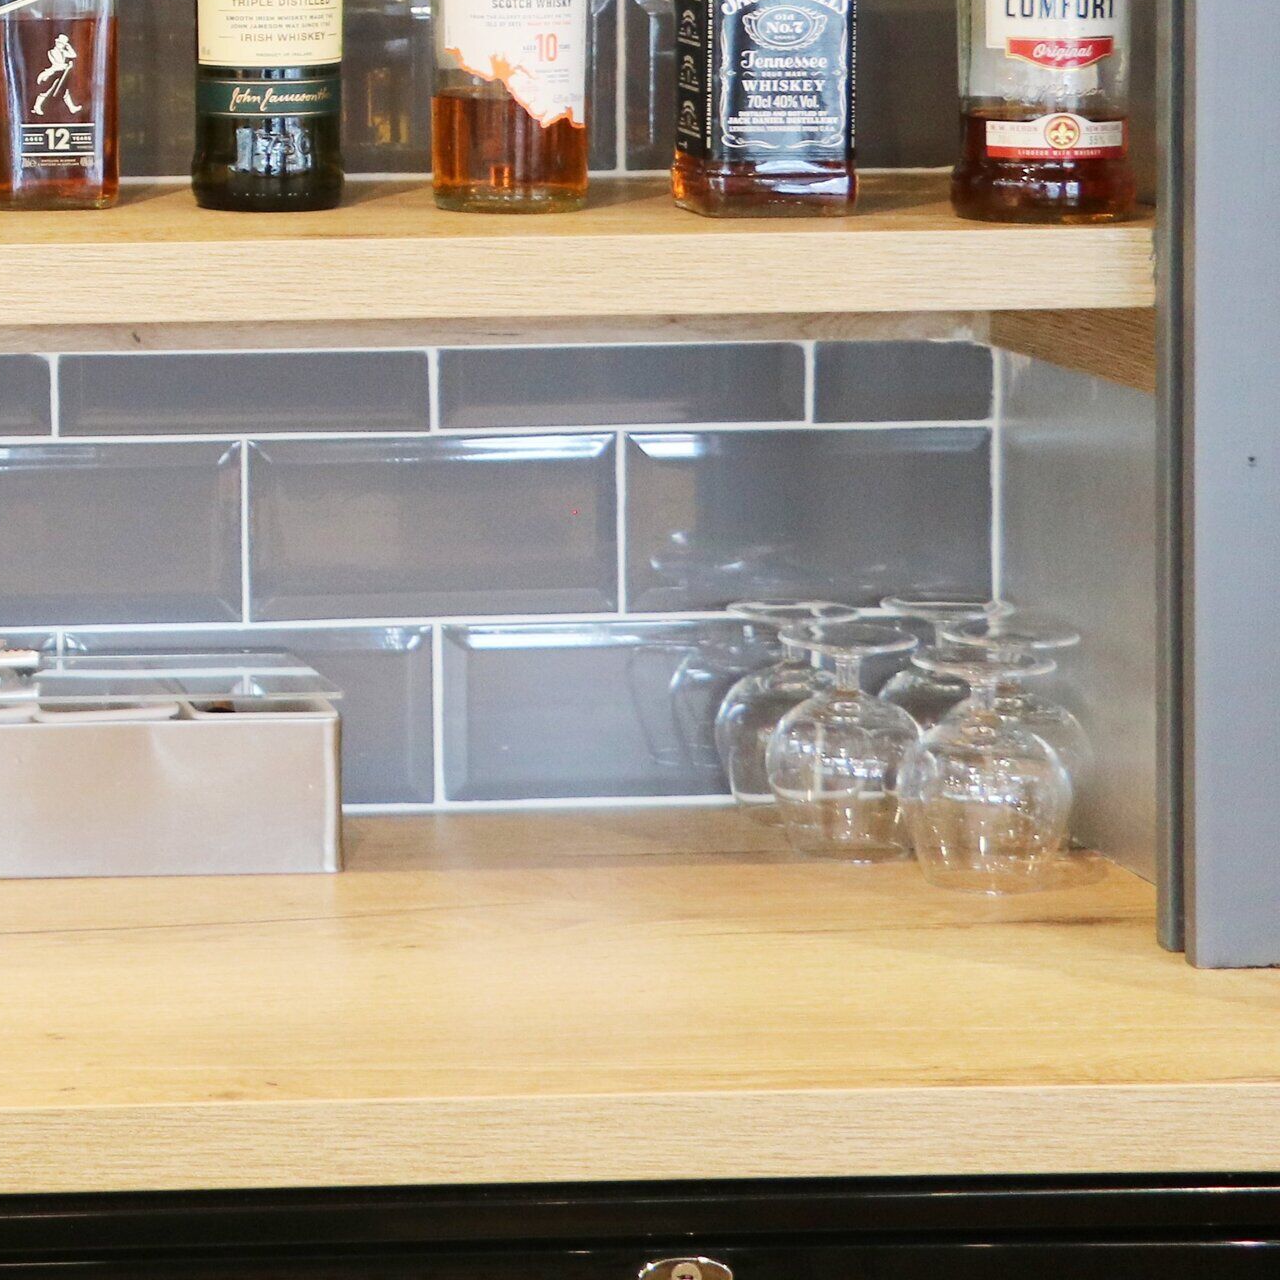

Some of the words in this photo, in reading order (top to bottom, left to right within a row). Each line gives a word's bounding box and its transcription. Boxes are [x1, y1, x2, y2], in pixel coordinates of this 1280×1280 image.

[240, 33, 274, 42] IRISH
[277, 31, 327, 42] WHISKEY
[535, 33, 558, 62] 10
[1032, 44, 1093, 61] Original
[740, 49, 829, 69] Tennessee
[740, 79, 827, 93] WHISKEY
[229, 86, 261, 112] John
[746, 94, 772, 109] 70cl
[773, 94, 798, 108] 40%
[799, 94, 820, 108] Vol.
[24, 135, 44, 143] AGED
[44, 127, 70, 151] 12
[72, 134, 92, 142] YEARS
